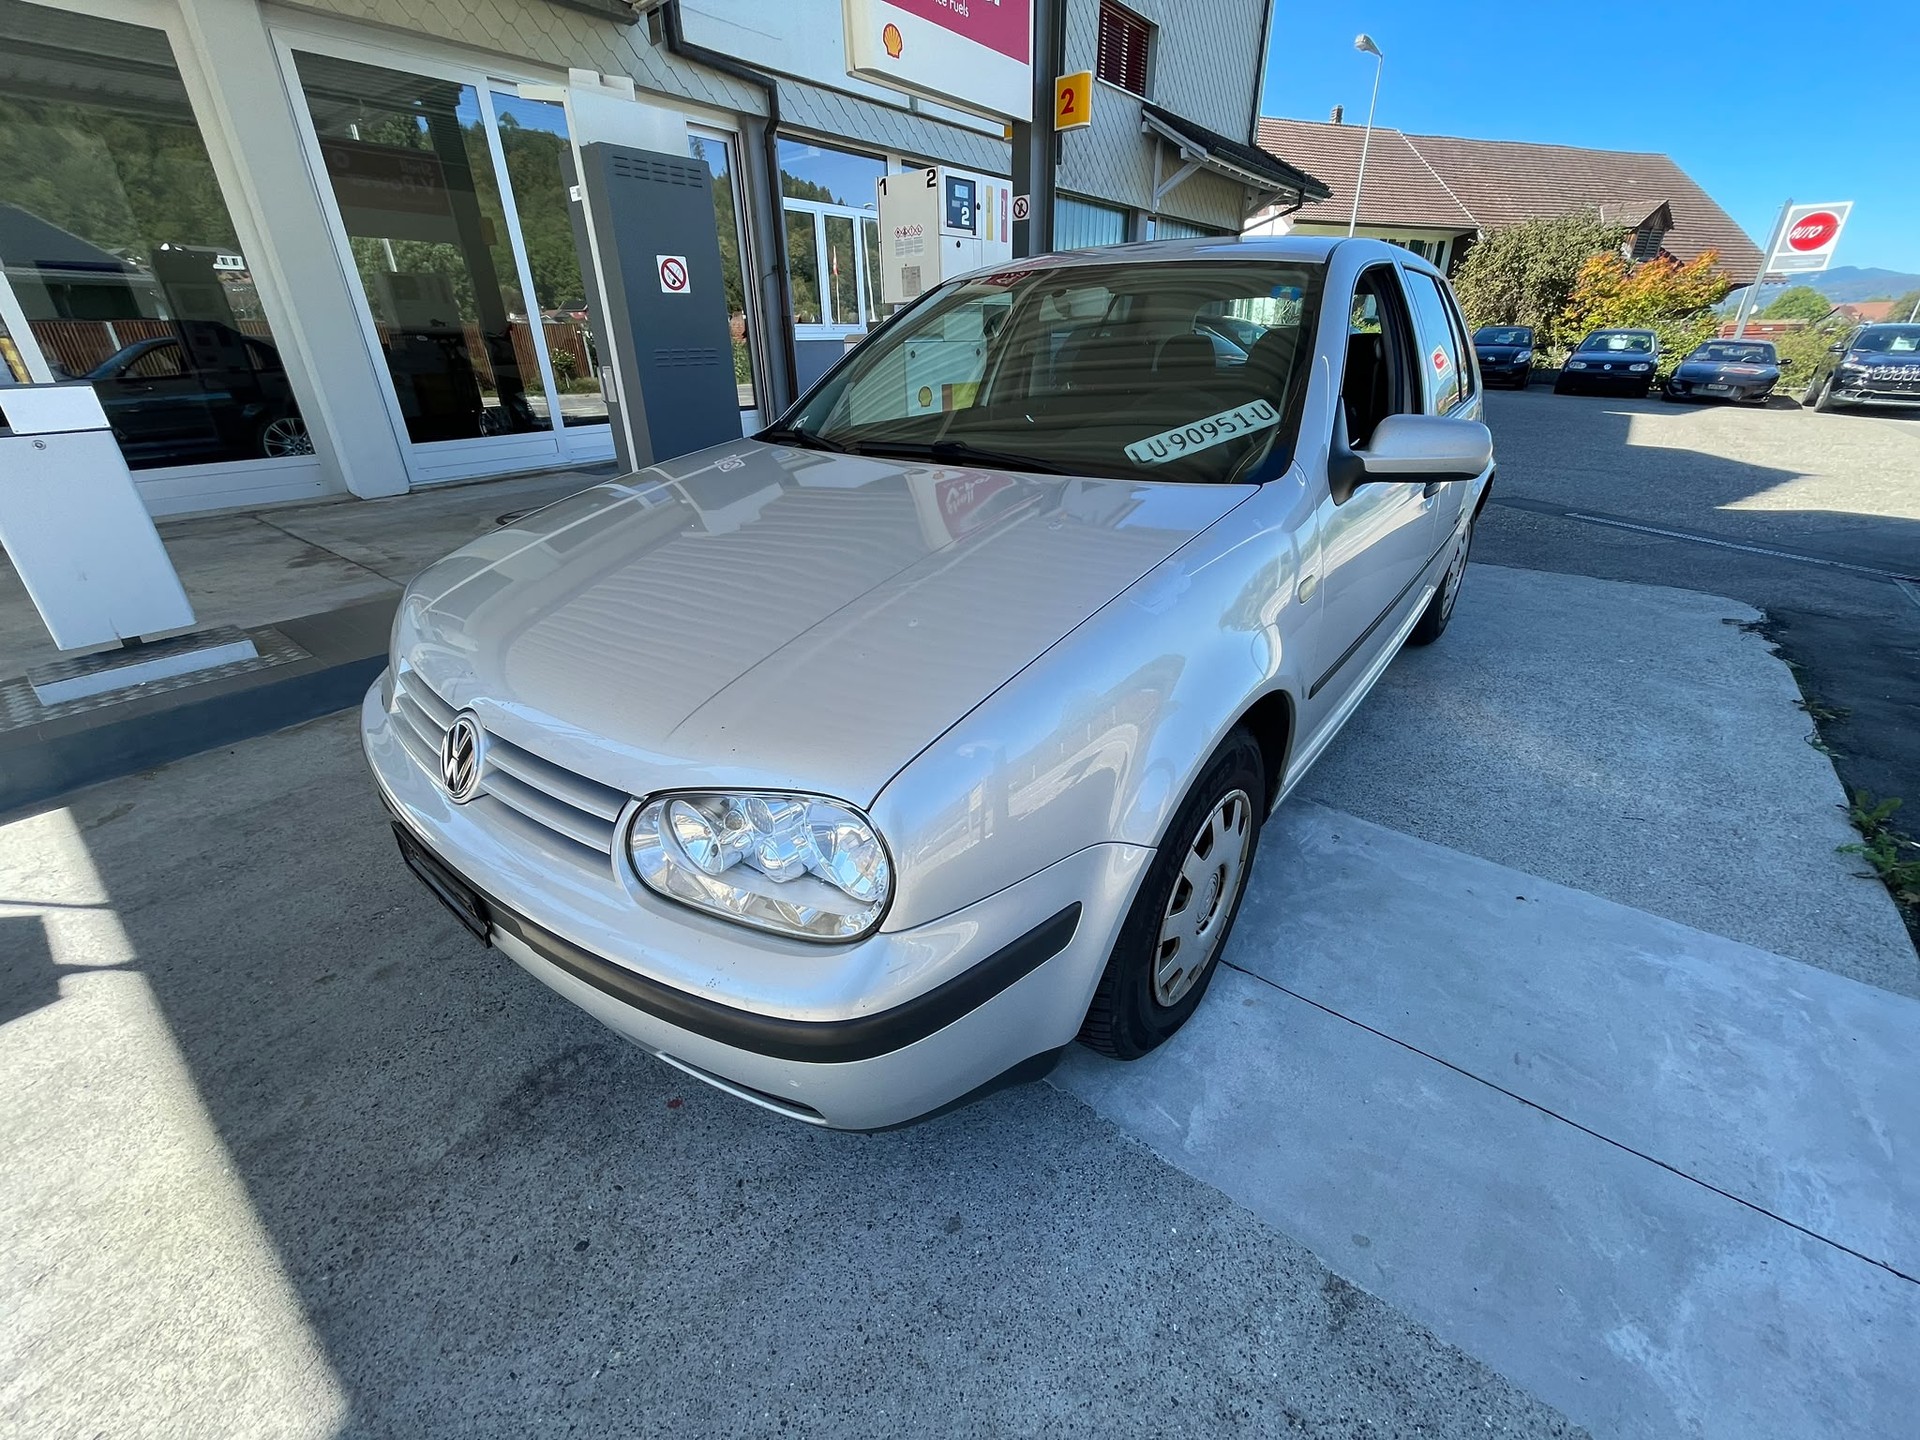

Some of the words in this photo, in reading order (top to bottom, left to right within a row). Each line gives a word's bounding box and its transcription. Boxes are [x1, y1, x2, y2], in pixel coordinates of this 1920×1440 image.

[1060, 88, 1075, 115] 2
[879, 178, 888, 196] 1
[926, 169, 937, 188] 2
[961, 206, 970, 226] 2
